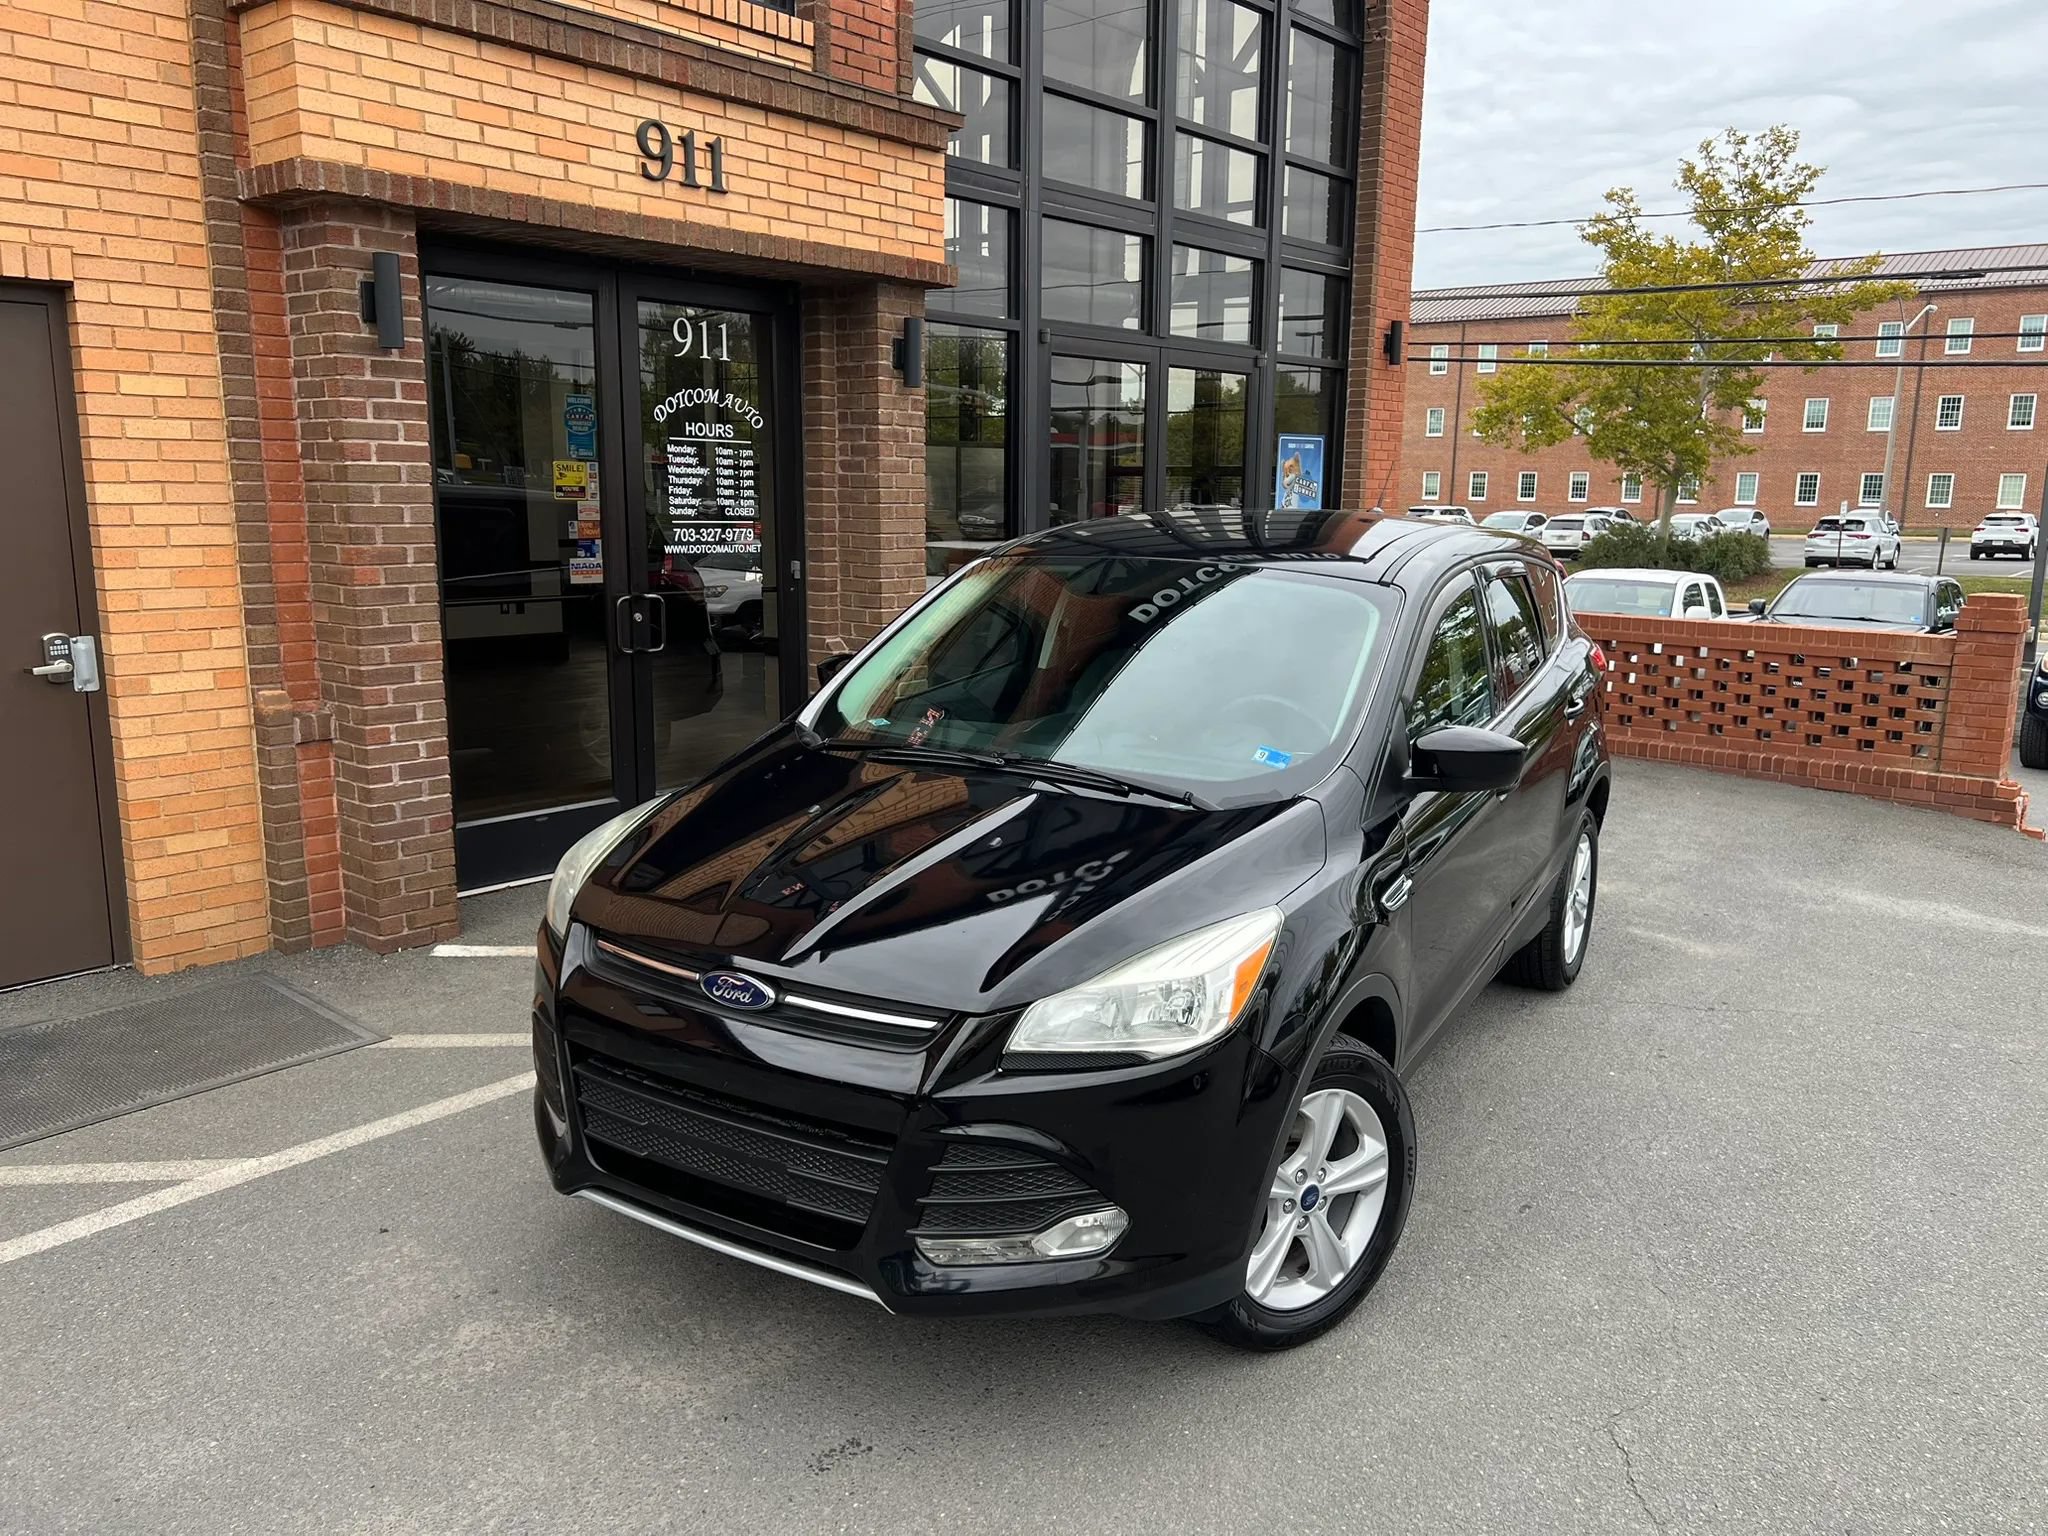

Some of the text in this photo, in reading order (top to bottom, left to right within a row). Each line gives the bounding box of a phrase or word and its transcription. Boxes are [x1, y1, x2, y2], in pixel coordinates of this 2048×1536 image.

[636, 119, 728, 194] 911
[673, 317, 731, 361] 911
[653, 388, 764, 429] DOTCOM AUTO
[685, 421, 734, 438] HOURS
[667, 444, 697, 455] Monday:
[715, 447, 733, 455] 10am
[667, 454, 699, 465] Tuesday:
[715, 457, 733, 465] 10am
[556, 463, 584, 473] SMILE!
[668, 465, 710, 476] Wednesday:
[716, 467, 734, 475] 10am
[668, 475, 702, 486] Thursday:
[716, 477, 734, 485] 10am
[668, 486, 692, 496] Friday:
[716, 487, 734, 495] 10am
[669, 496, 702, 507] Saturday:
[717, 497, 735, 506] 10am
[669, 506, 755, 517] Sunday: CLOSED
[673, 528, 754, 542] 703-327-9779
[664, 545, 762, 554] WWW.DOTCOMAUTO.NET
[712, 975, 755, 1003] Ford
